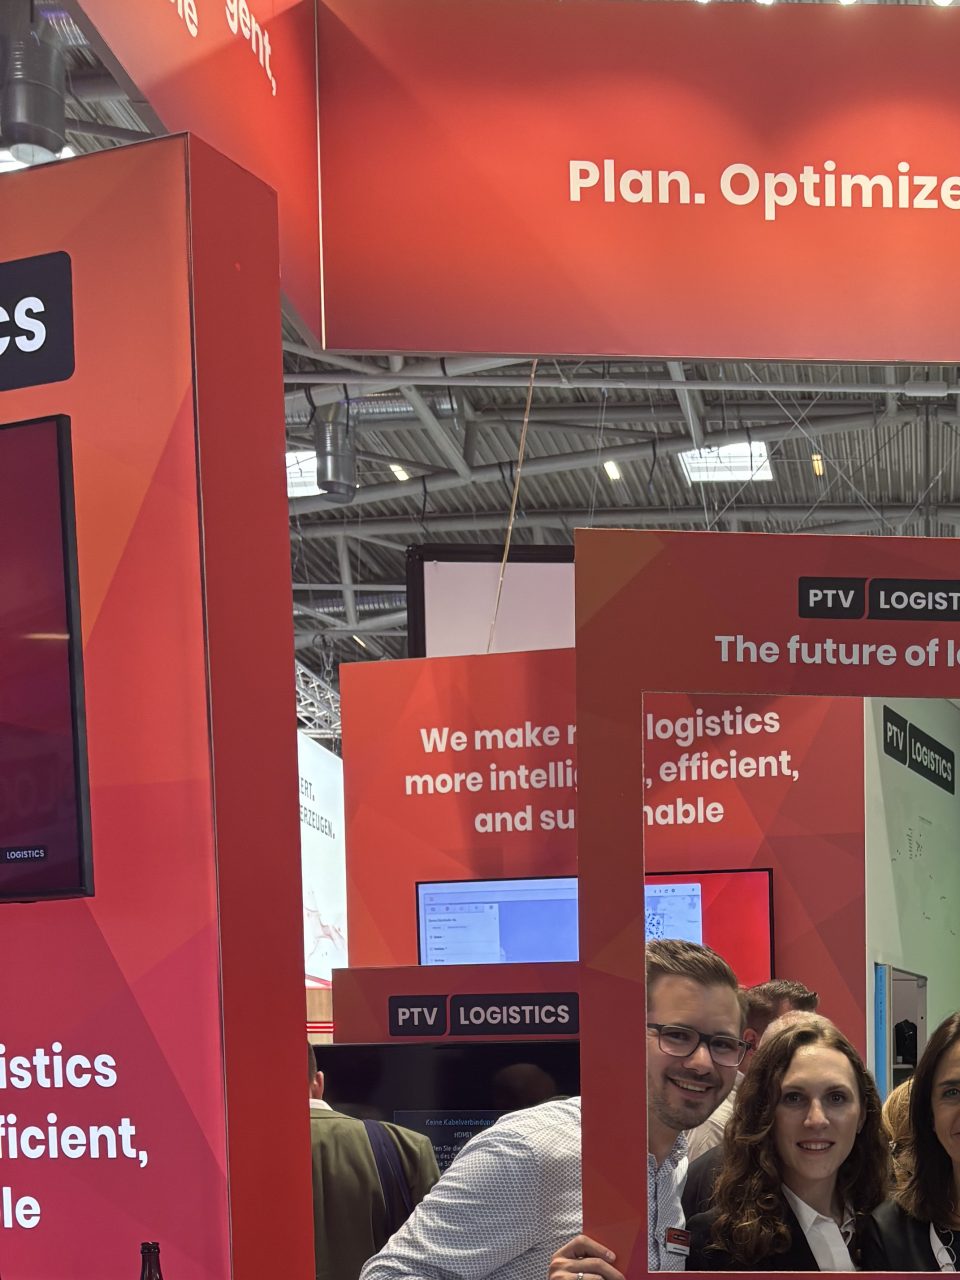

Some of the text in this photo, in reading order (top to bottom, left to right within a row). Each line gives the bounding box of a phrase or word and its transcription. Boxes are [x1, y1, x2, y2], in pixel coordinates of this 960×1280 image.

[569, 159, 705, 205] Plan.
[809, 589, 855, 608] PTV
[714, 635, 780, 663] The
[787, 635, 898, 667] future
[904, 638, 939, 667] of
[420, 727, 468, 753] We
[474, 721, 560, 750] make
[646, 705, 781, 747] logistics
[886, 721, 952, 782] PTV LOGISTICS
[405, 771, 483, 795] more
[659, 750, 799, 783] efficient,
[474, 805, 533, 833] and
[6, 850, 45, 860] LOGISTICS
[398, 1005, 570, 1025] PTV LOGISTICS
